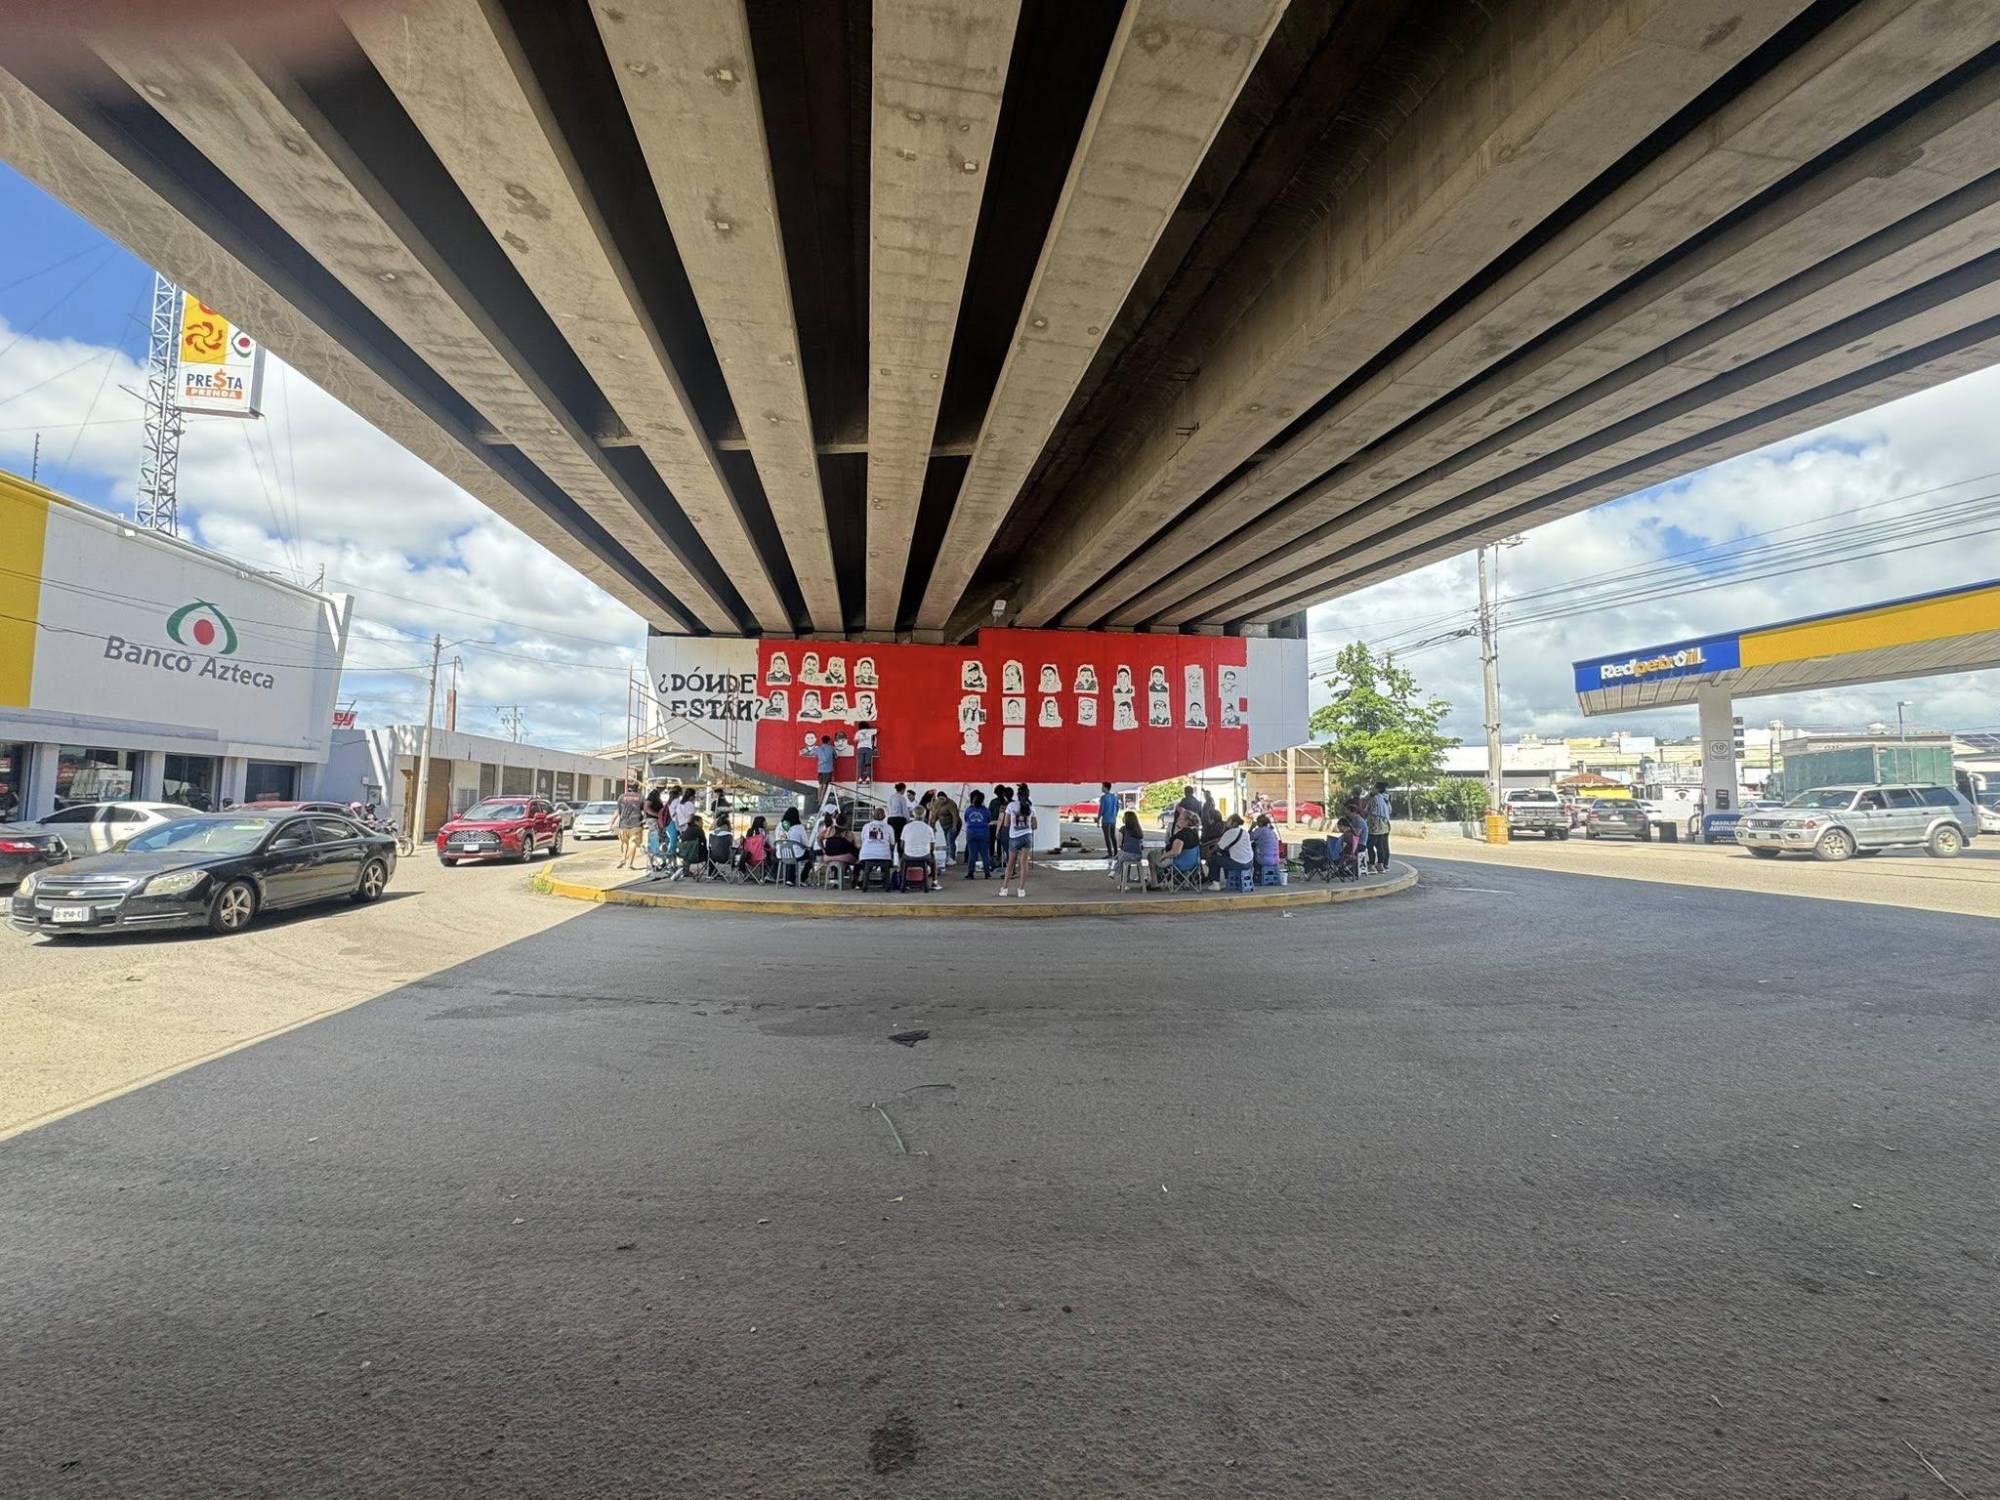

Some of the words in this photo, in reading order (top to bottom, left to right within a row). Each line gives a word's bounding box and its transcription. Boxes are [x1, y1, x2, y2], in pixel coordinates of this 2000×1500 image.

[190, 387, 236, 398] PRENDA
[103, 635, 192, 673] Banco
[198, 656, 275, 690] Azteca
[658, 666, 757, 694] ¿DÓNDE
[670, 694, 764, 721] ESTÁN?
